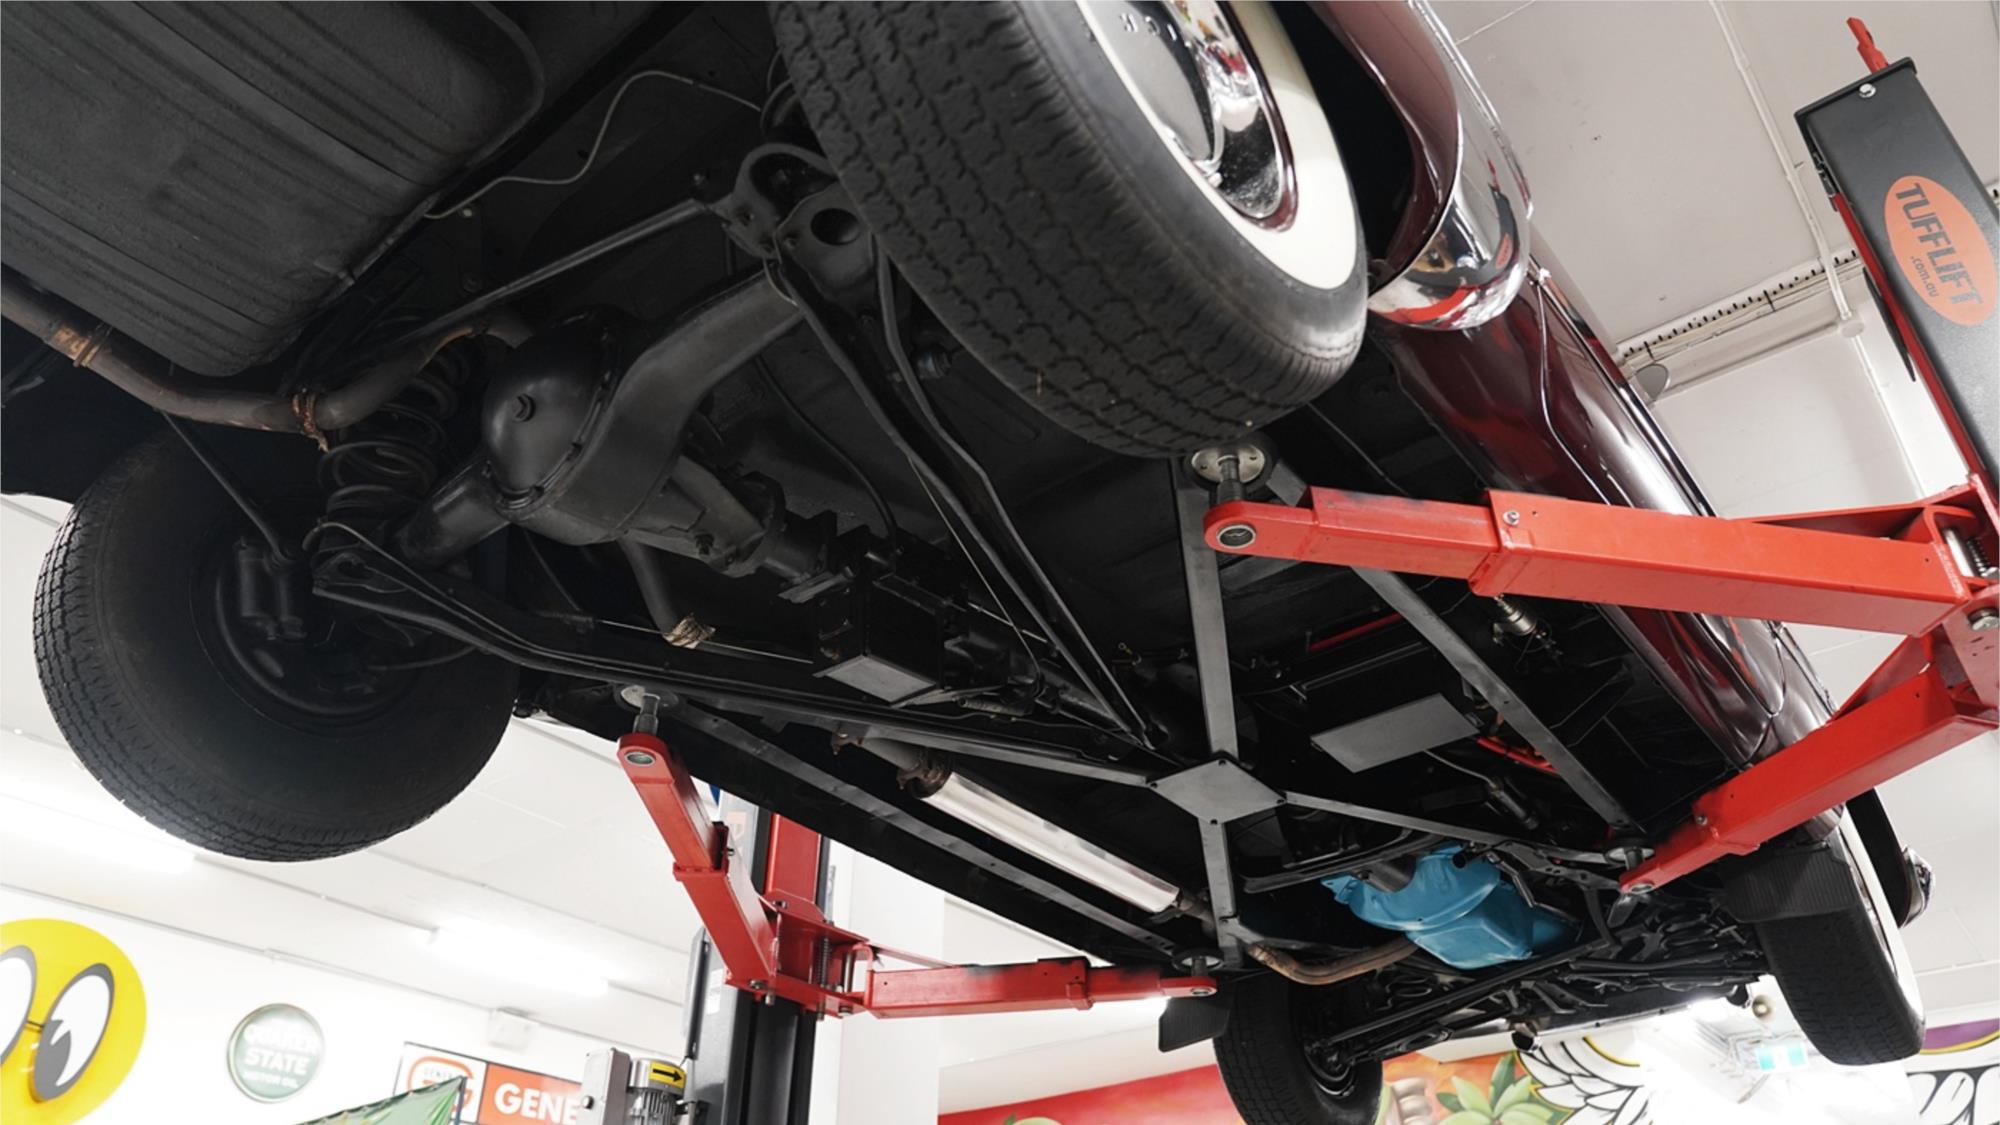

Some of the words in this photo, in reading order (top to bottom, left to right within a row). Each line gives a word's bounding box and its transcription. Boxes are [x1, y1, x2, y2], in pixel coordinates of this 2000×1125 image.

[1896, 182, 1983, 304] TUFFLIFT
[1910, 256, 1939, 297] .com.au
[244, 1047, 311, 1076] STATE
